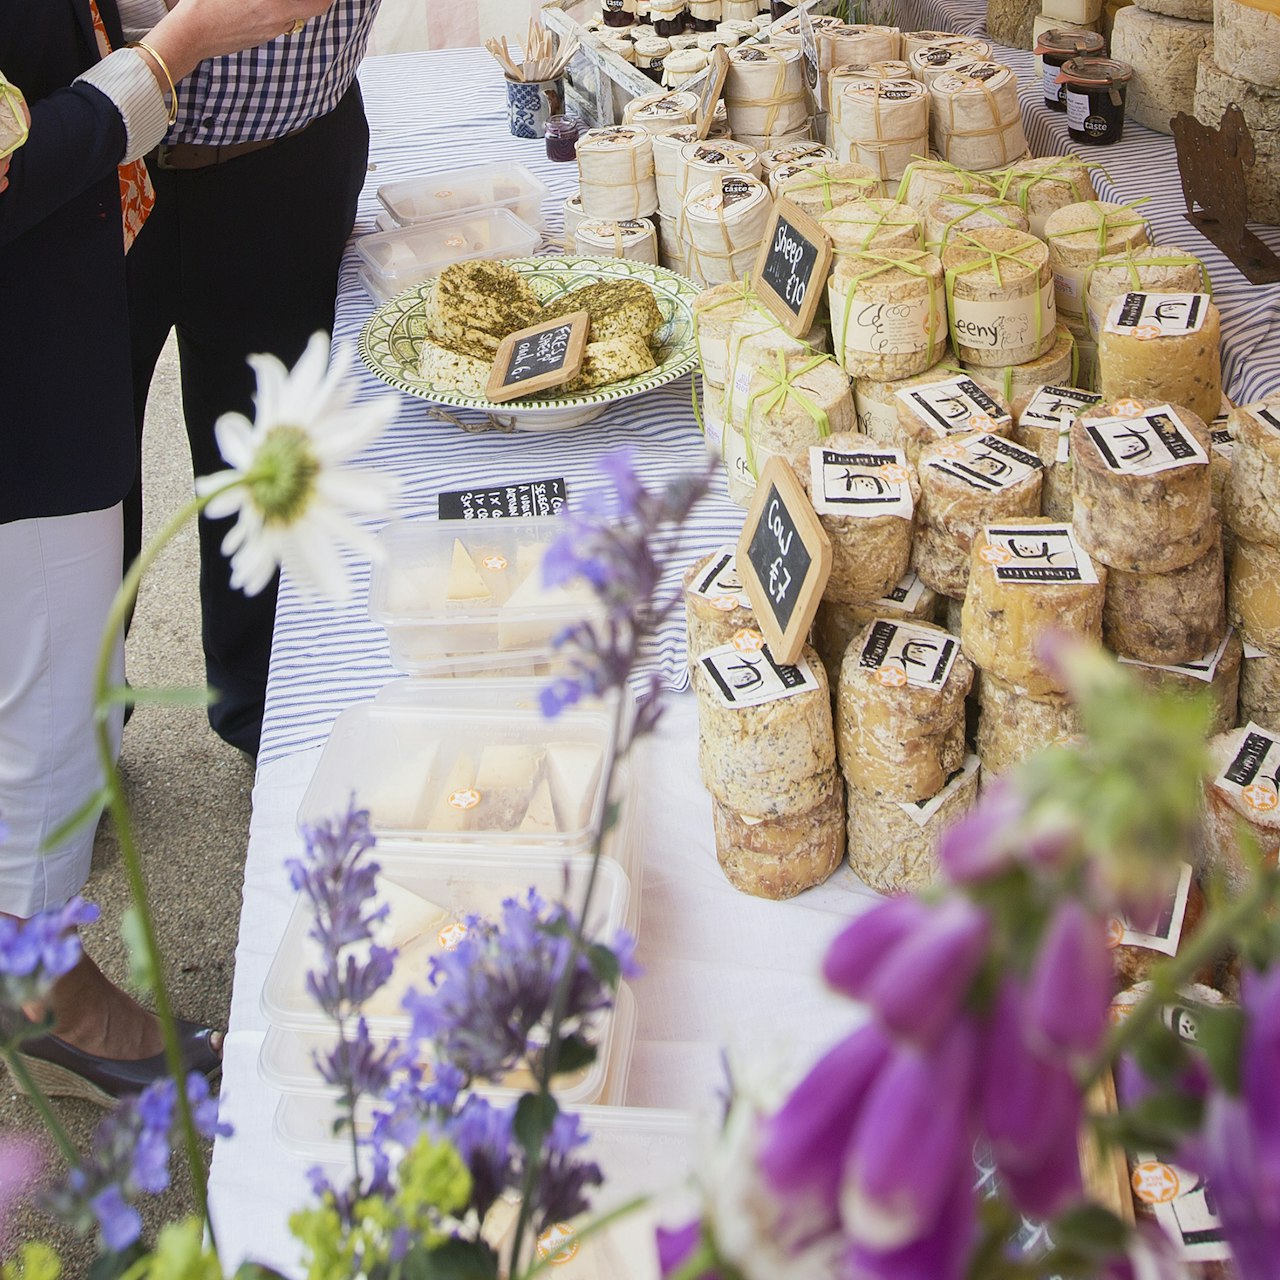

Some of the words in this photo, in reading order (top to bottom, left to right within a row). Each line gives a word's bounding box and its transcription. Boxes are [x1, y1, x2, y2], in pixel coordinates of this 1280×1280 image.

[1085, 123, 1108, 131] taste
[775, 224, 803, 274] Sheep
[785, 273, 805, 306] €10
[555, 326, 572, 363] FRESH
[954, 318, 998, 346] eeny
[768, 499, 793, 556] Cow
[769, 556, 792, 604] €7
